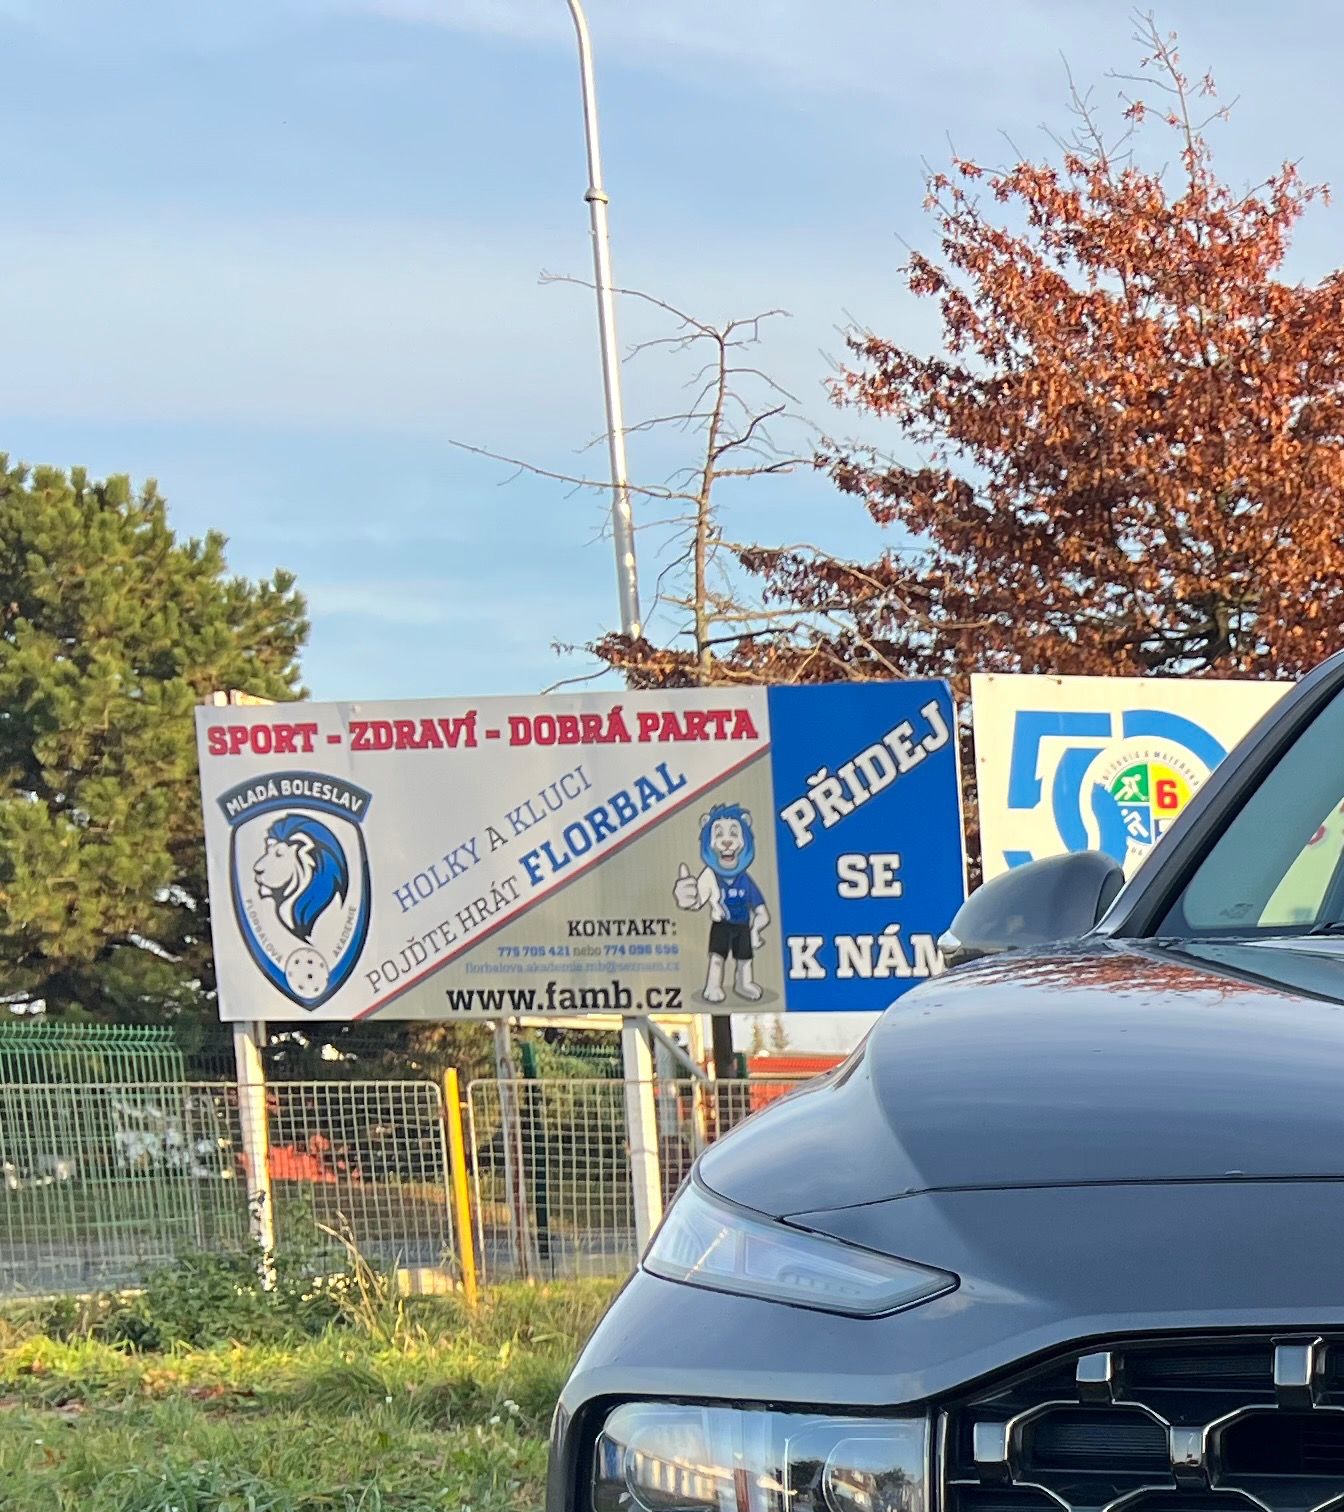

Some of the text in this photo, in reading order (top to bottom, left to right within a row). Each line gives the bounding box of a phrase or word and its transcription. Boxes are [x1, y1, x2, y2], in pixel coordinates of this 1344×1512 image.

[207, 722, 318, 756] SPORT
[350, 710, 478, 751] ZDRAVÍ
[508, 705, 632, 747] DOBRÁ
[637, 709, 759, 742] PARTA
[780, 699, 951, 848] PŘIDEJ
[1156, 780, 1178, 809] 6
[225, 779, 362, 817] MLADÁ BOLESLAV
[391, 765, 593, 914] HOLKY A KLUCI
[364, 761, 688, 995] POJĎTE HRÁT FLORBAL
[836, 853, 902, 899] SE
[567, 918, 677, 937] KONTAKT:
[572, 945, 601, 957] nebo
[787, 935, 827, 980] K
[446, 980, 683, 1011] www.famb.cz
